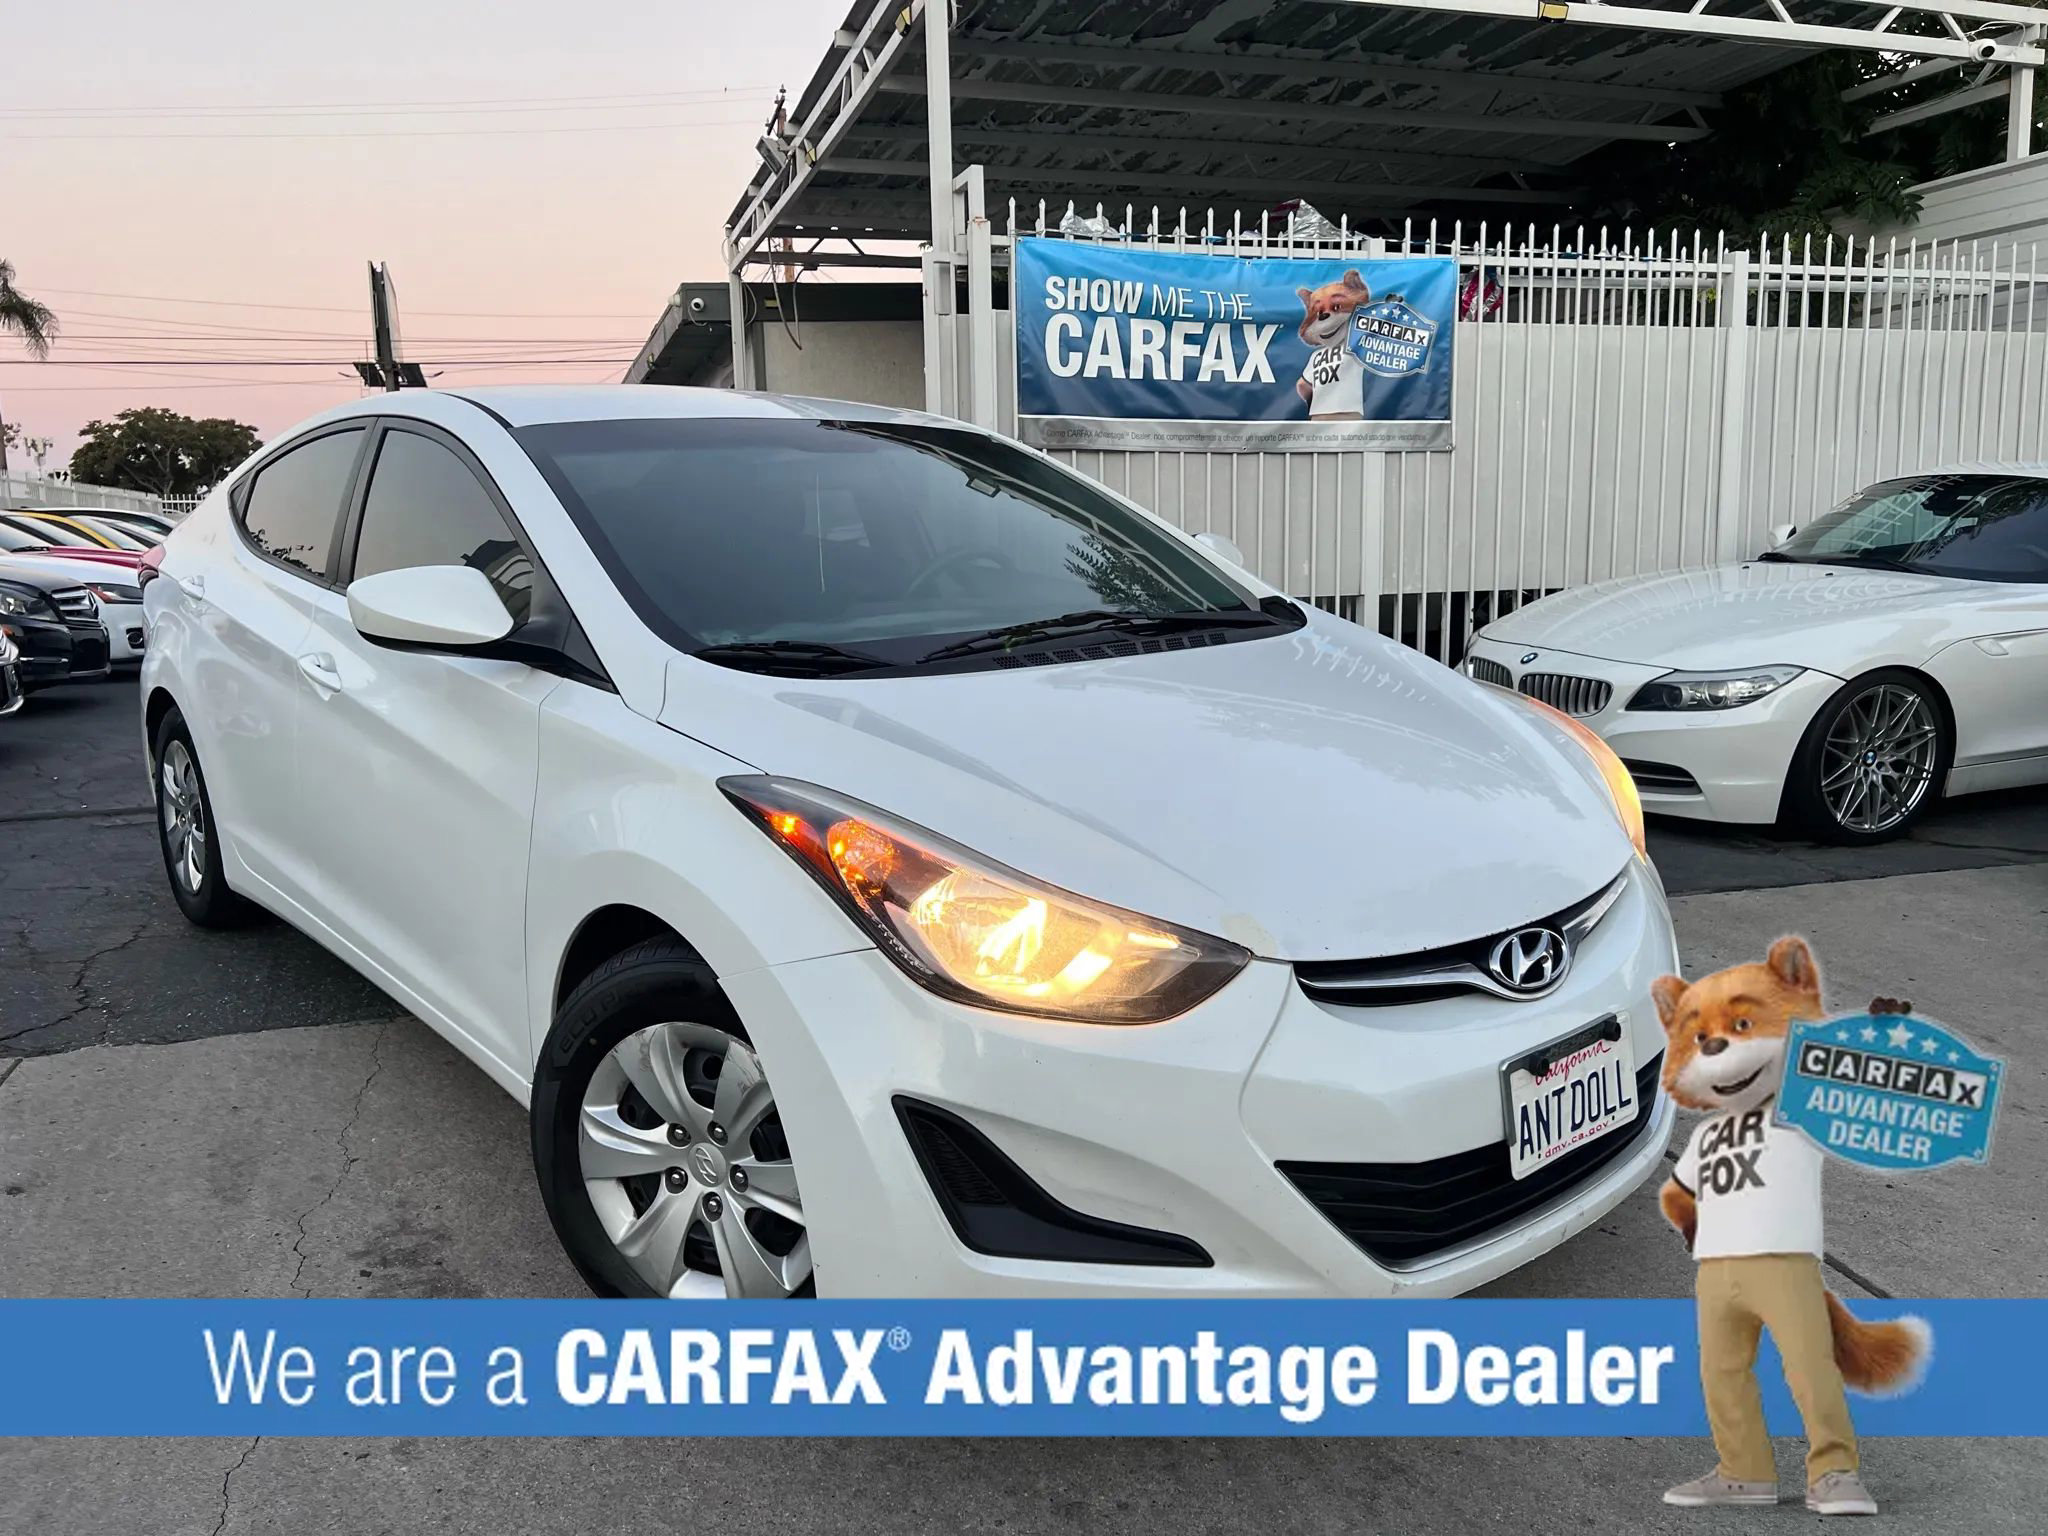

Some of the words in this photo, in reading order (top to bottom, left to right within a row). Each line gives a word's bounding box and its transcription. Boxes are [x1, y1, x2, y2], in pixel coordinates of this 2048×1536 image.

[1045, 275, 1144, 314] SHOW
[1151, 284, 1194, 318] ME
[1199, 290, 1253, 320] THE
[1356, 317, 1428, 346] CARFAX
[1045, 313, 1279, 384] CARFAX
[1312, 346, 1342, 368] CAR
[1358, 335, 1421, 360] ADVANTAGE
[1366, 351, 1408, 371] DEALER
[1313, 364, 1341, 388] FOX
[1067, 429, 1093, 438] CARFAX
[1545, 1120, 1609, 1159] dmv.ca.gov
